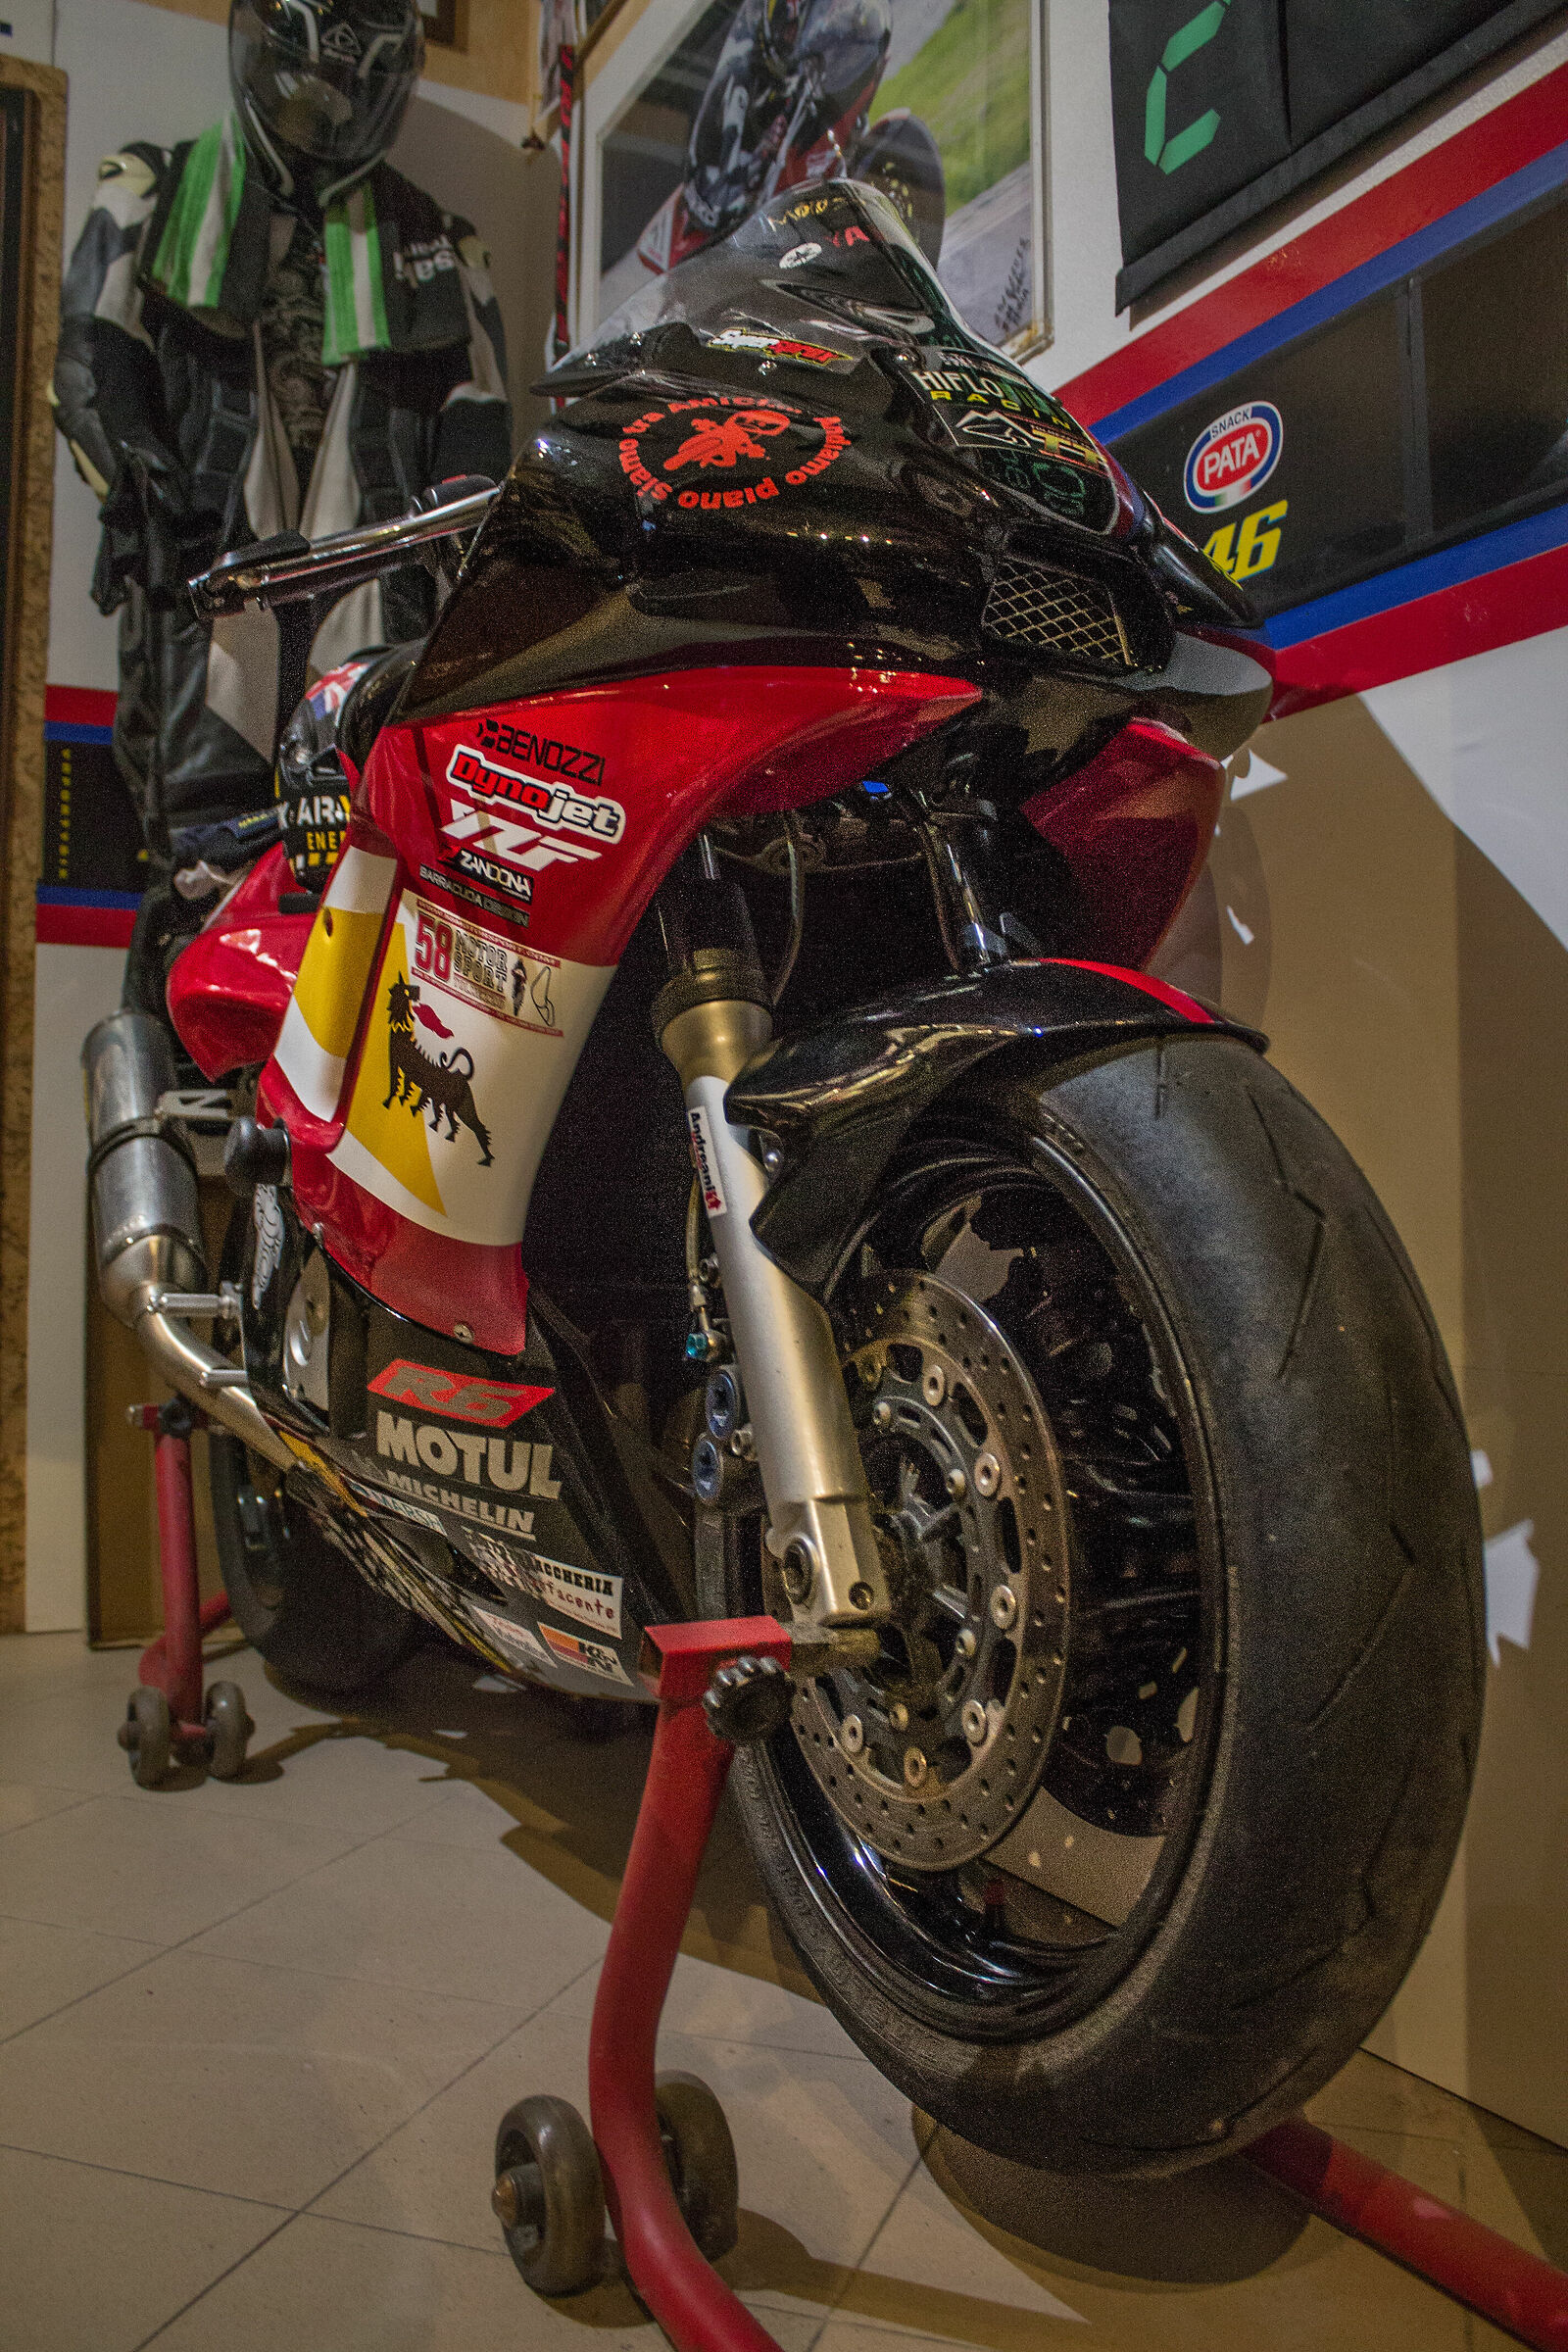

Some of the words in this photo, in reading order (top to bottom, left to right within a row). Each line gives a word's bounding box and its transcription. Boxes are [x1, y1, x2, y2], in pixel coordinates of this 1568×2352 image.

[931, 391, 1072, 430] RACIN
[1211, 408, 1252, 440] SNACK
[619, 439, 673, 500] siamo
[1203, 430, 1261, 485] PATA
[678, 476, 780, 510] piano
[1201, 500, 1289, 583] 46
[450, 751, 622, 838] Dynojet
[416, 910, 454, 983] 58
[690, 1111, 716, 1192] Andreani
[383, 1365, 526, 1421] R6
[376, 1409, 563, 1501] MOTUL
[386, 1469, 535, 1535] MICHELIN
